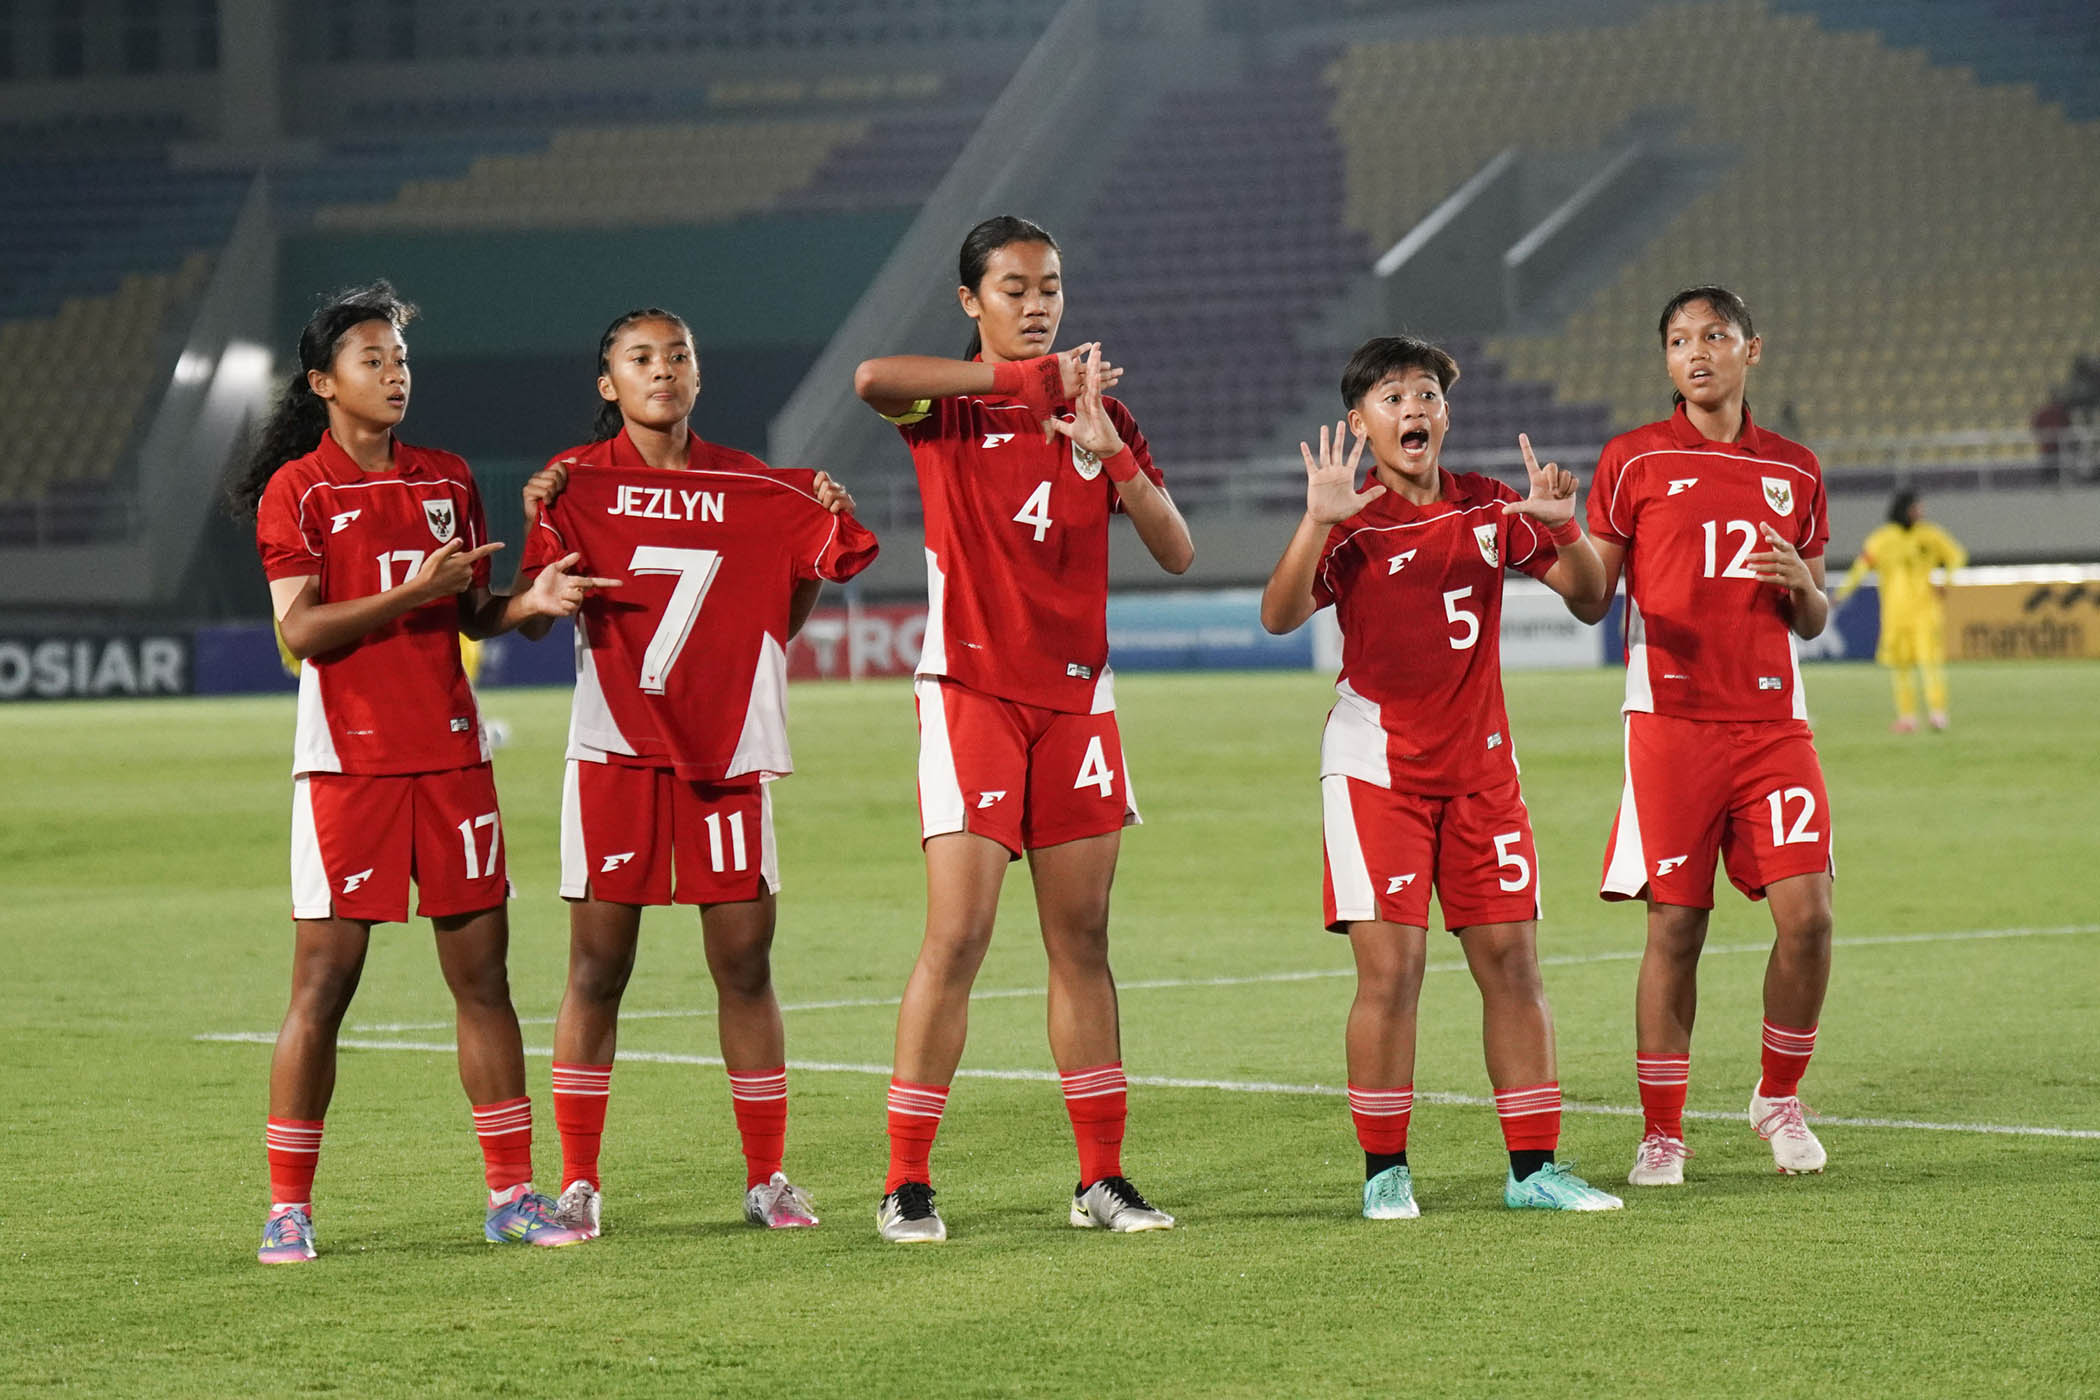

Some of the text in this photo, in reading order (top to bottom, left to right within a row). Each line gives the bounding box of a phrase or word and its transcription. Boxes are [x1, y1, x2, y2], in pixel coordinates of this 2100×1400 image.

[607, 485, 725, 523] JEZLYN
[1012, 480, 1053, 542] 4
[375, 549, 425, 593] 17
[1702, 519, 1758, 580] 12
[627, 545, 724, 696] 7
[1442, 585, 1480, 650] 5
[0, 638, 183, 695] OSIAR
[1073, 735, 1114, 798] 4
[457, 811, 500, 880] 17
[704, 810, 748, 873] 11
[1766, 786, 1820, 848] 12
[1493, 830, 1530, 892] 5
